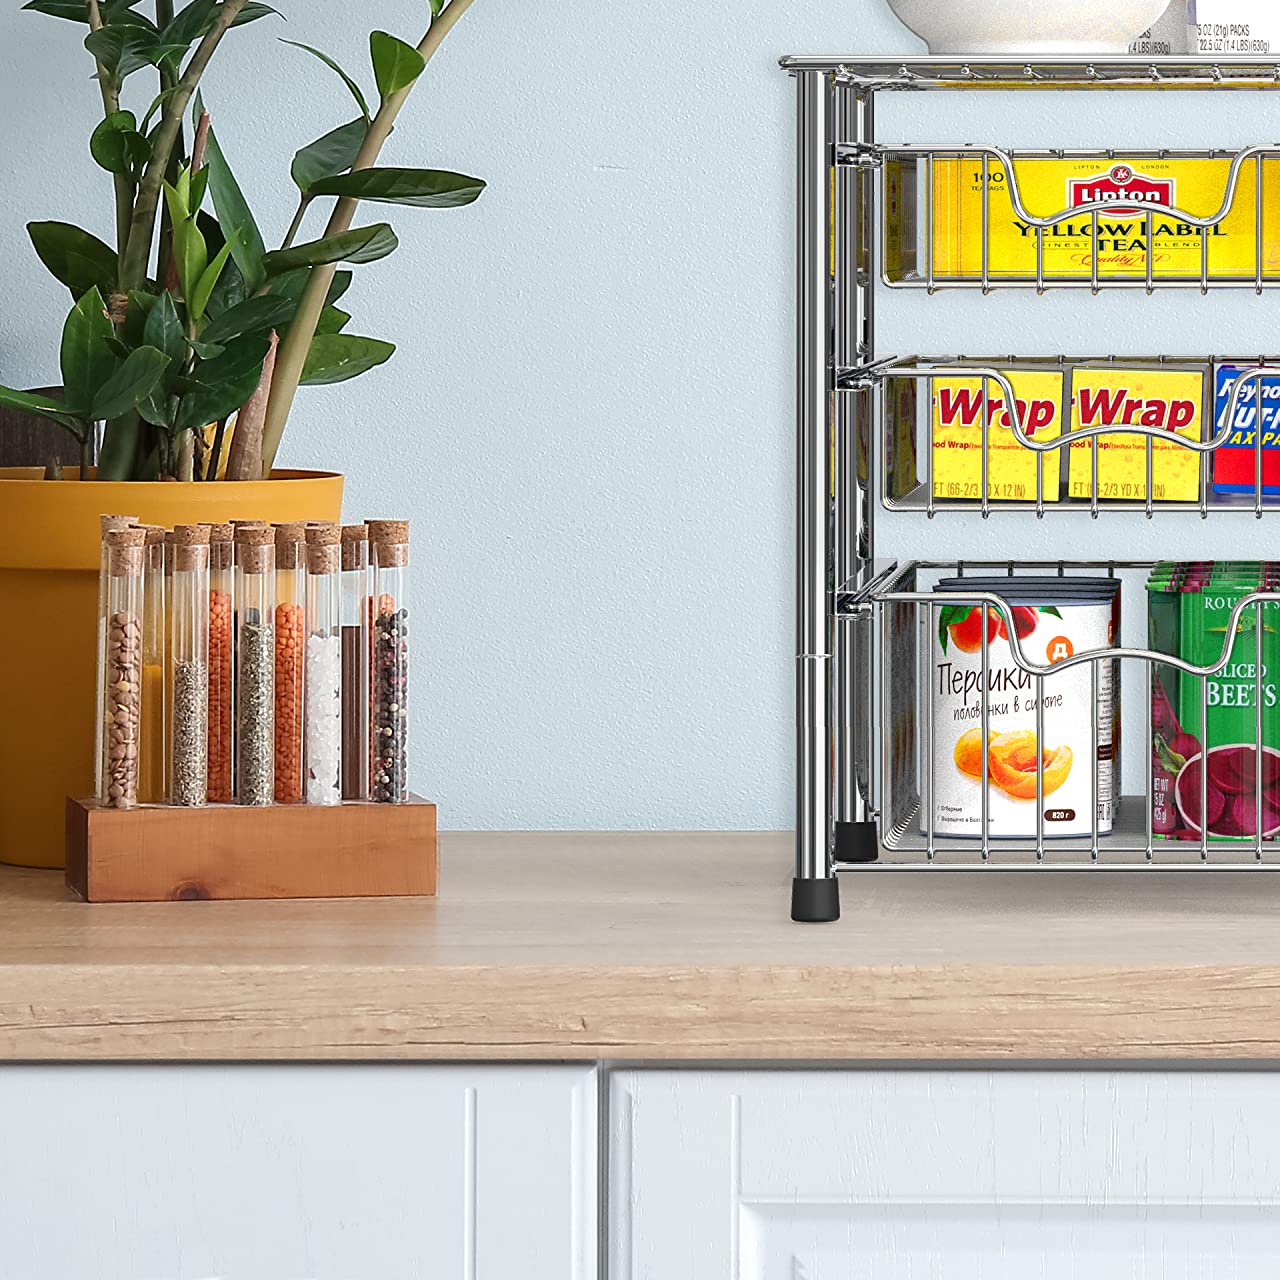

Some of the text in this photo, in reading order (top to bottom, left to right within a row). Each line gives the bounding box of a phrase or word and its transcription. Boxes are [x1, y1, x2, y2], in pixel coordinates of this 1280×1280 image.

[1230, 24, 1250, 36] PACKS
[973, 172, 1004, 183] 100
[1081, 188, 1161, 203] Lipton
[1012, 221, 1227, 237] YELLOW LABEL
[1097, 239, 1147, 251] TEA
[939, 388, 1056, 436] Wrap
[1079, 388, 1195, 433] Wrap
[933, 482, 944, 495] FT
[947, 482, 979, 497] (66-2/3
[994, 484, 1000, 497] X
[1003, 484, 1012, 497] 12
[1073, 482, 1084, 495] FT
[1121, 483, 1132, 497] YD
[1134, 484, 1140, 497] X
[1052, 643, 1068, 660] Д
[1207, 682, 1277, 707] BEETS
[953, 700, 1009, 720] половнки
